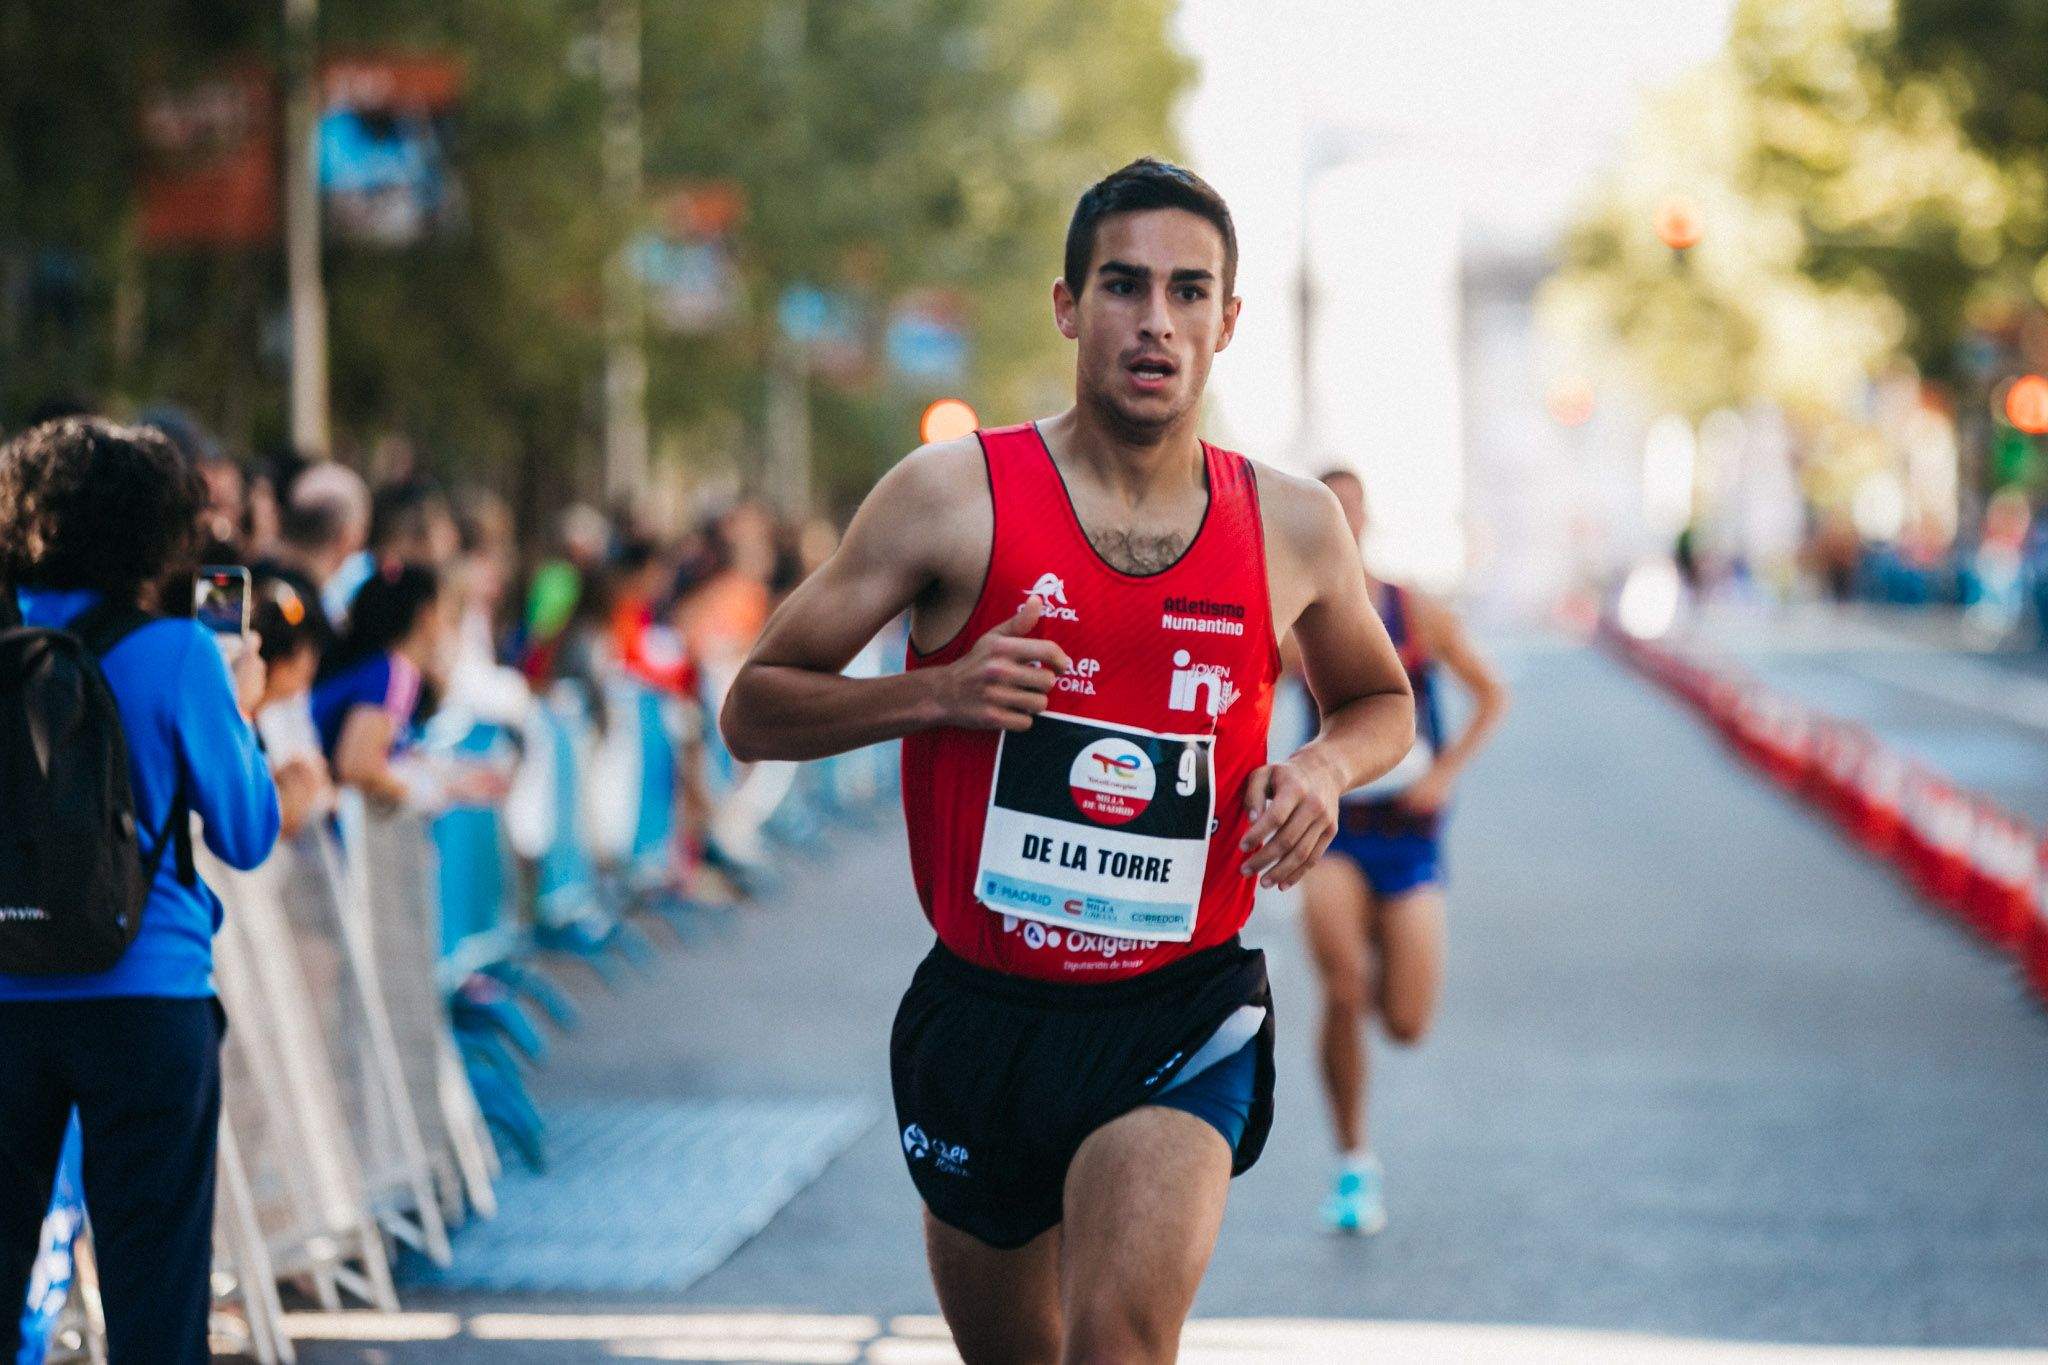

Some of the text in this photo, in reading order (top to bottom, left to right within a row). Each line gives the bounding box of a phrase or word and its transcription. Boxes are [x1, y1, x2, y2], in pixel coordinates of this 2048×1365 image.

[1162, 614, 1244, 636] Numantino
[1175, 749, 1197, 797] 9
[1022, 834, 1173, 883] DE LA TORRE
[1001, 884, 1052, 907] MADRID
